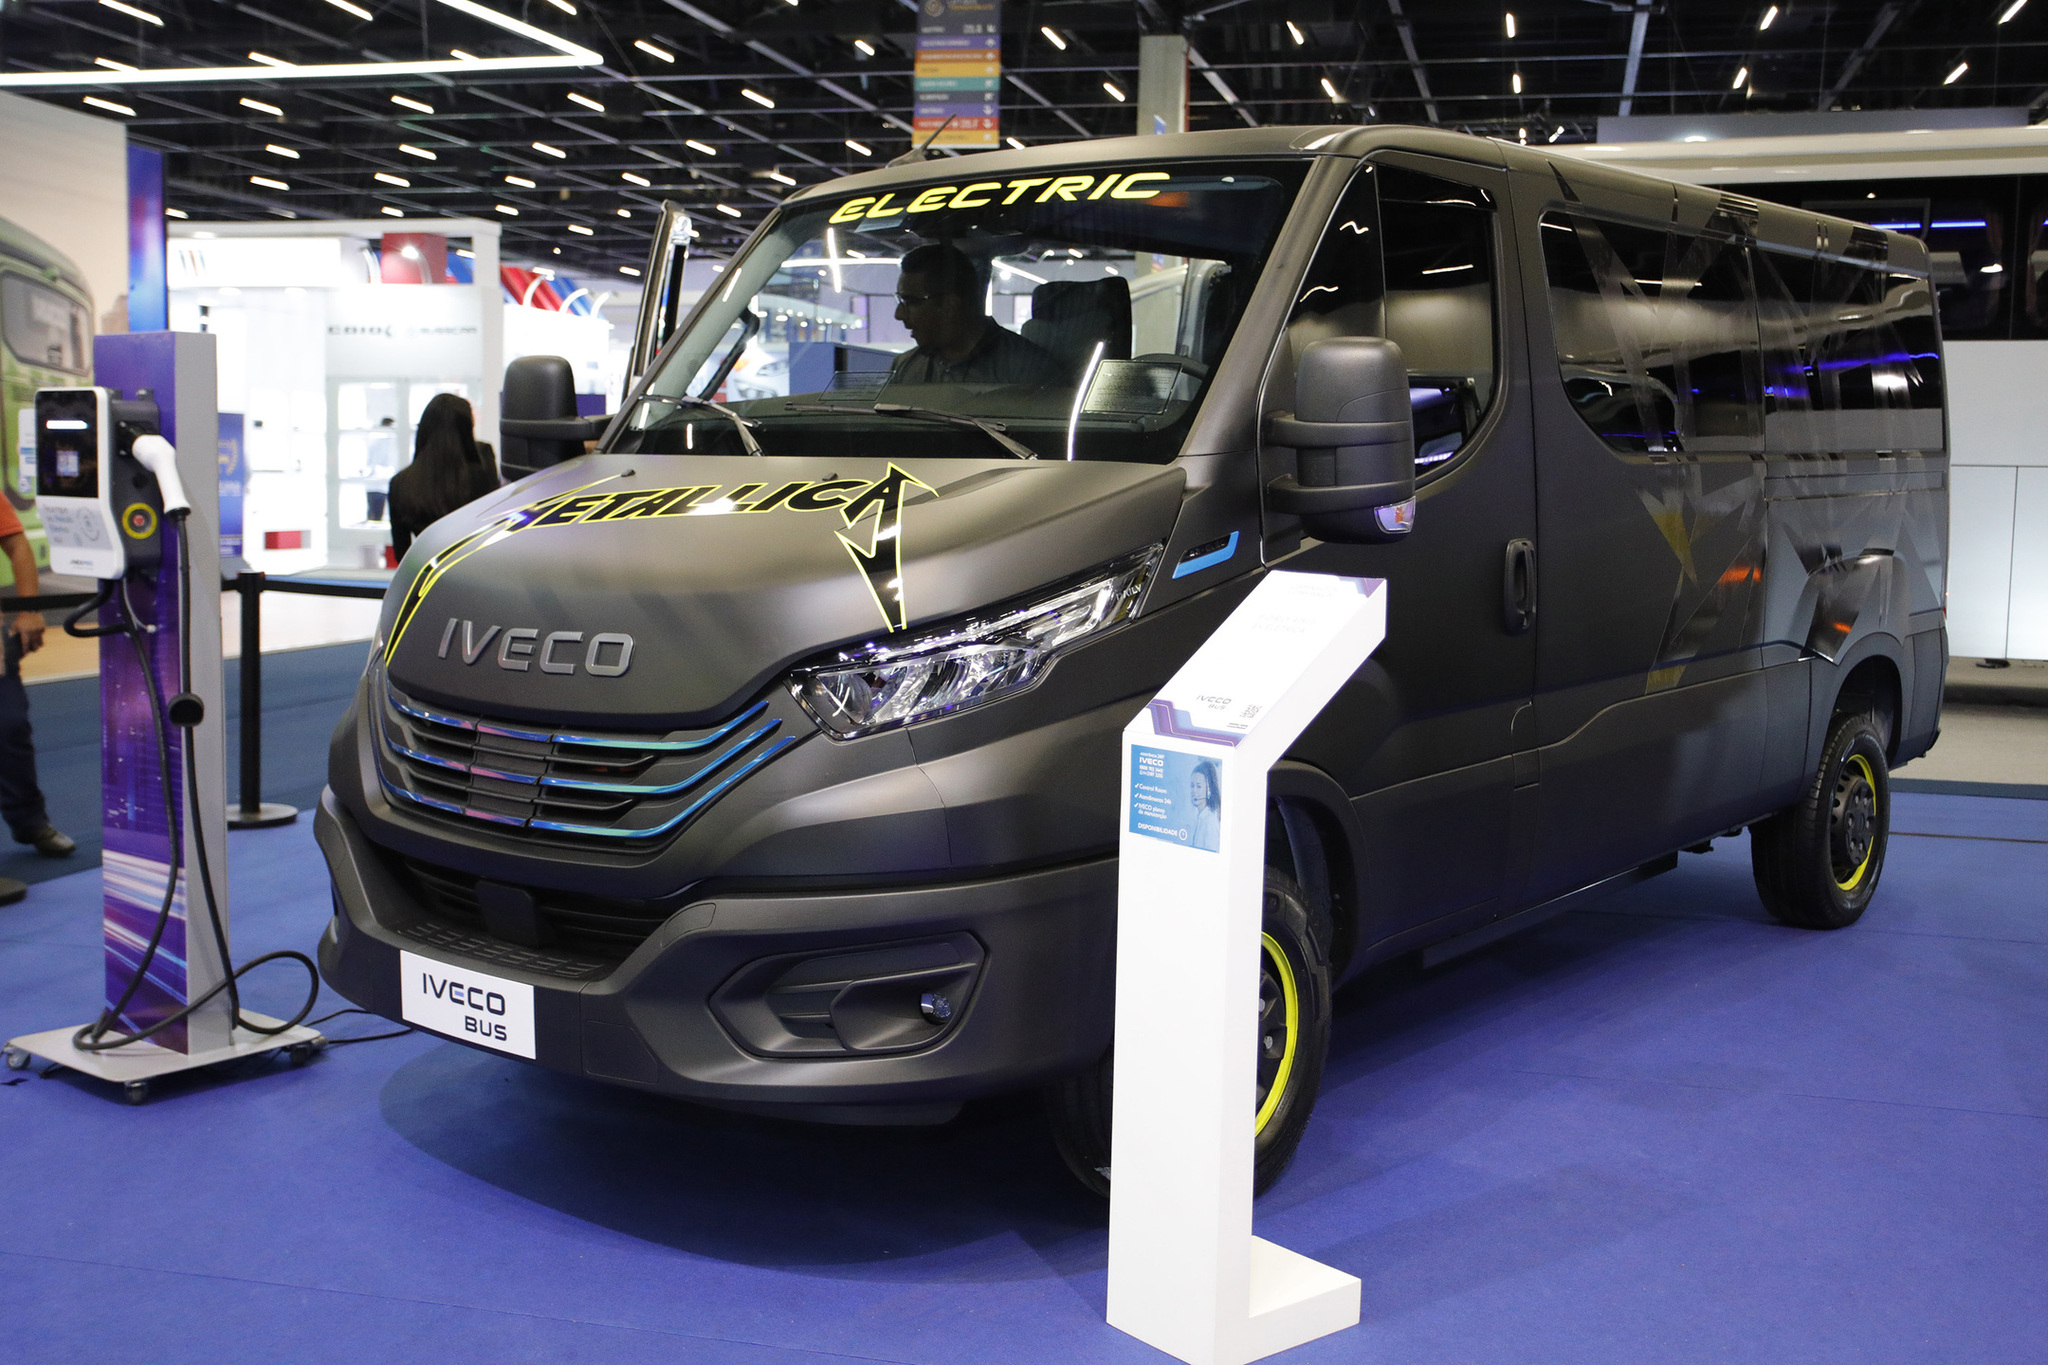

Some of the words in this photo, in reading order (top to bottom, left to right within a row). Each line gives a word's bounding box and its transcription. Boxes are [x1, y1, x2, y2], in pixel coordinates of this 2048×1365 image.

[829, 172, 1170, 224] ELECTRIC
[385, 462, 938, 668] METALLICA
[438, 617, 637, 678] IVECO
[1196, 695, 1232, 705] IVECO
[1139, 756, 1164, 767] IVECO
[1138, 822, 1178, 837] DISPONIBILIDADE
[423, 972, 506, 1016] IVECO
[465, 1015, 507, 1042] BUS
